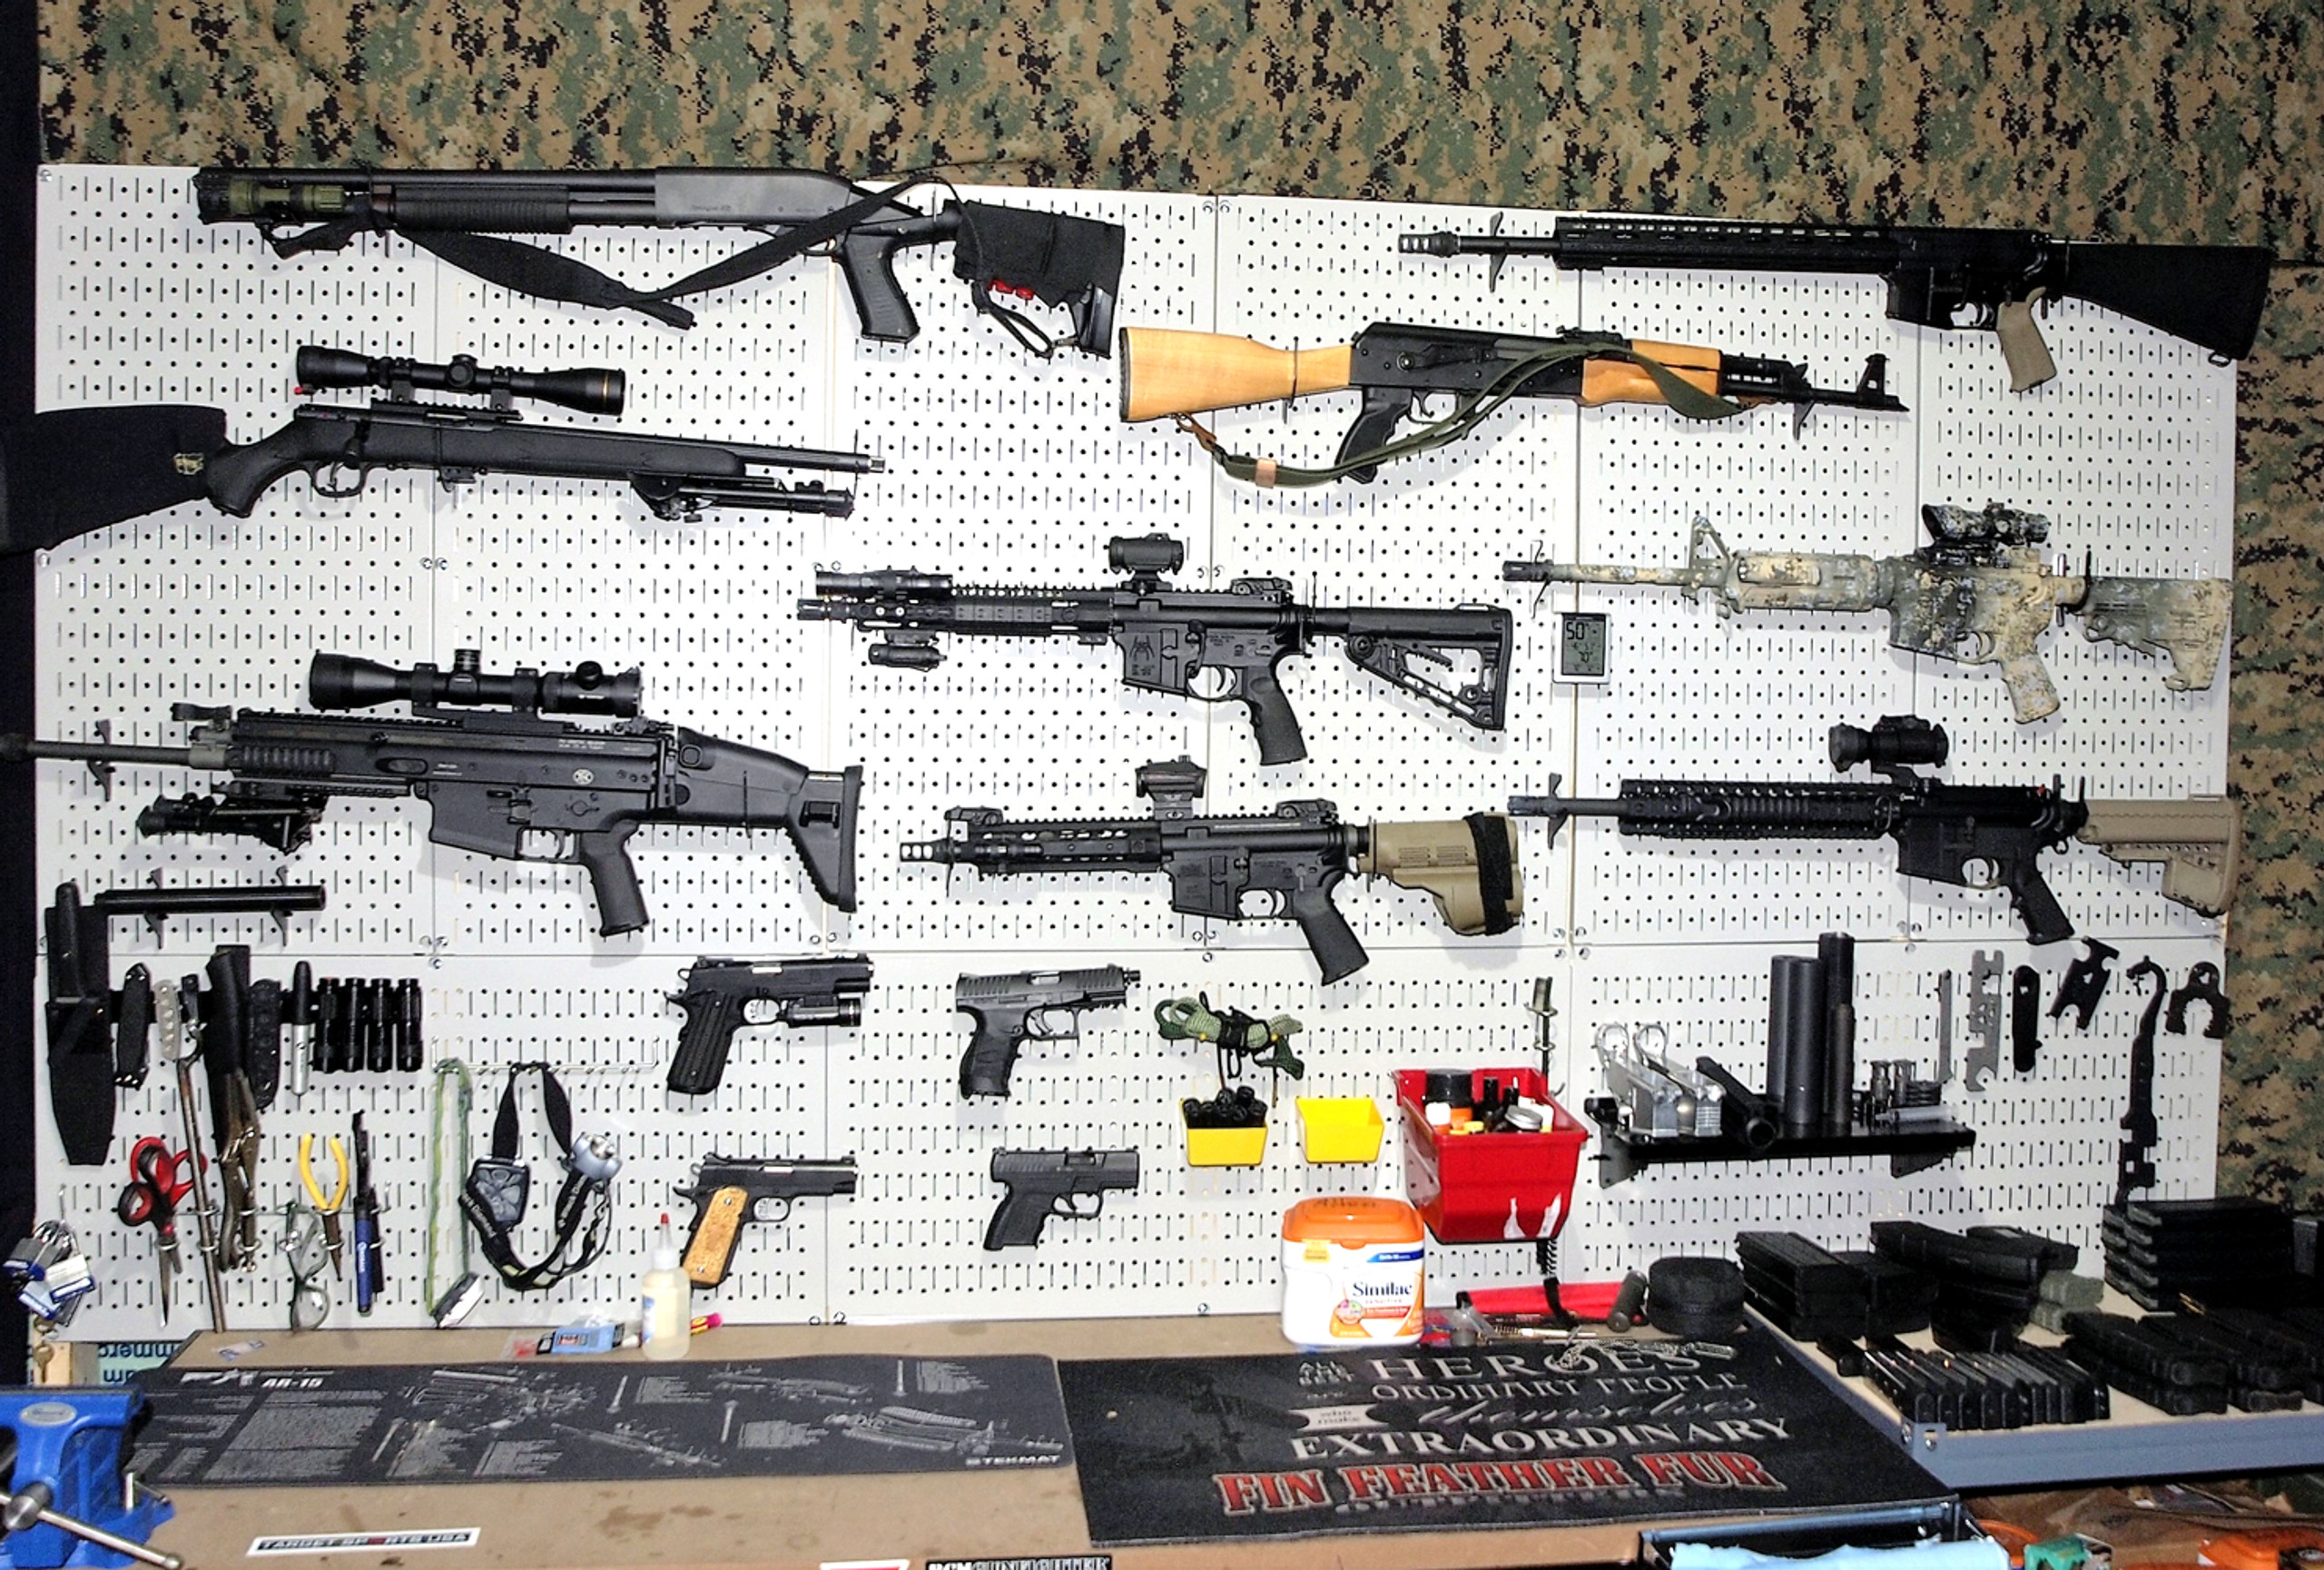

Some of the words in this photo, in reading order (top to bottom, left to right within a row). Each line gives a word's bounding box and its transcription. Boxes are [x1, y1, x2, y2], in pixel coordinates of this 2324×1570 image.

[1353, 1281, 1413, 1298] Similac
[1368, 1350, 1700, 1380] HEROES
[261, 1377, 325, 1388] AR-15
[1372, 1379, 1580, 1400] ORDINARY
[1596, 1373, 1748, 1395] PEOPLE
[1418, 1393, 1758, 1425] themselves
[1290, 1417, 1790, 1459] EXTRAORDINARY
[982, 1455, 1060, 1466] TEKMAT
[1212, 1469, 1332, 1516] FIN
[1336, 1456, 1640, 1500] FEATHER
[1633, 1452, 1787, 1492] FUR
